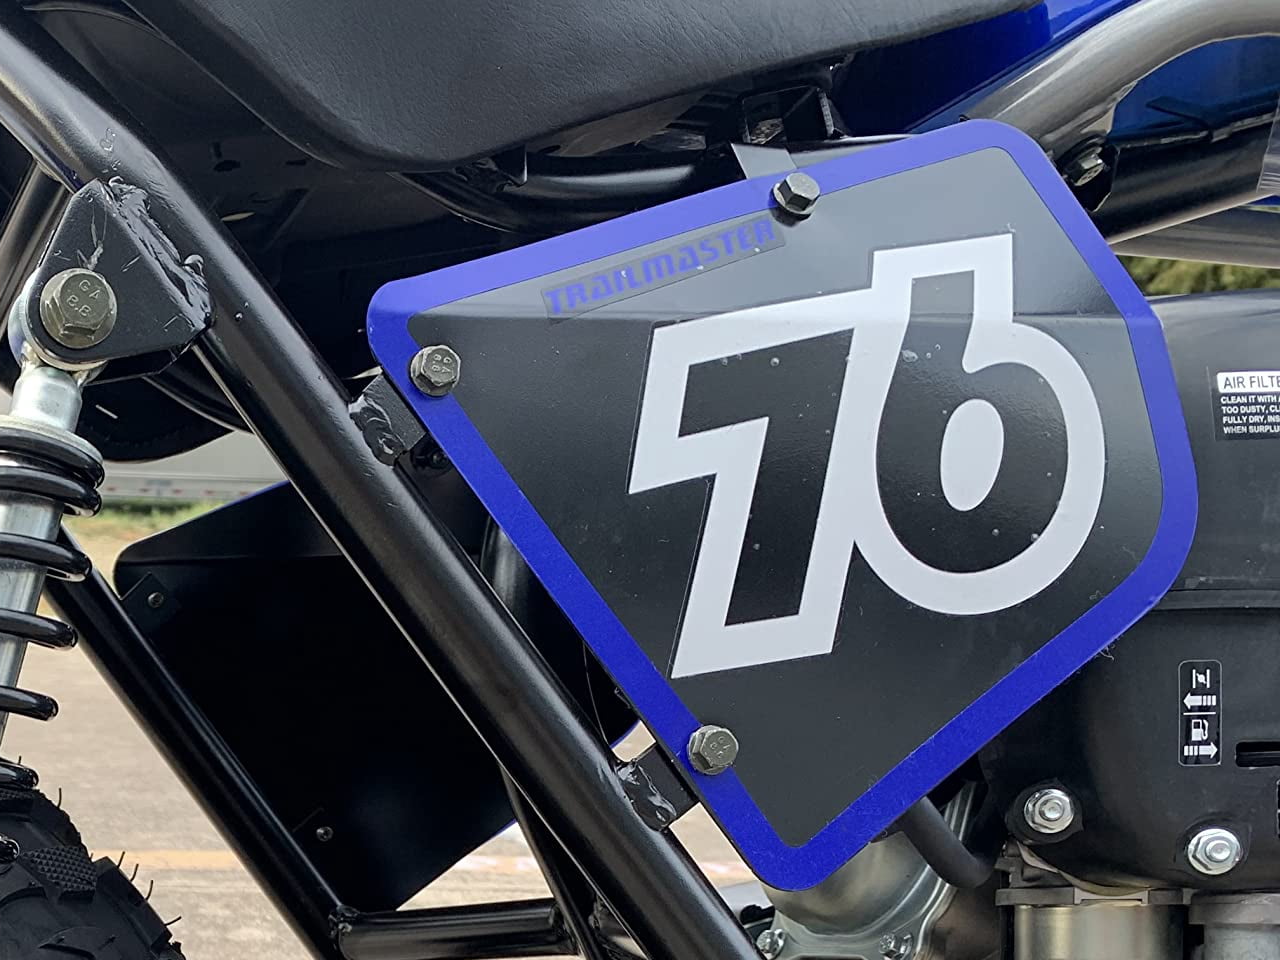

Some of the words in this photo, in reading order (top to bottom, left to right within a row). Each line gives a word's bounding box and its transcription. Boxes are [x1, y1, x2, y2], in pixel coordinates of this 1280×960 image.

[544, 217, 776, 316] TRAILMASTER
[1223, 376, 1246, 389] AIR
[1220, 395, 1247, 404] CLEAN
[1248, 395, 1256, 403] IT
[1257, 394, 1277, 403] WITH
[1221, 405, 1239, 414] TOO
[1222, 415, 1247, 424] FULLY
[1223, 425, 1248, 434] WHEN
[628, 233, 1106, 681] 76
